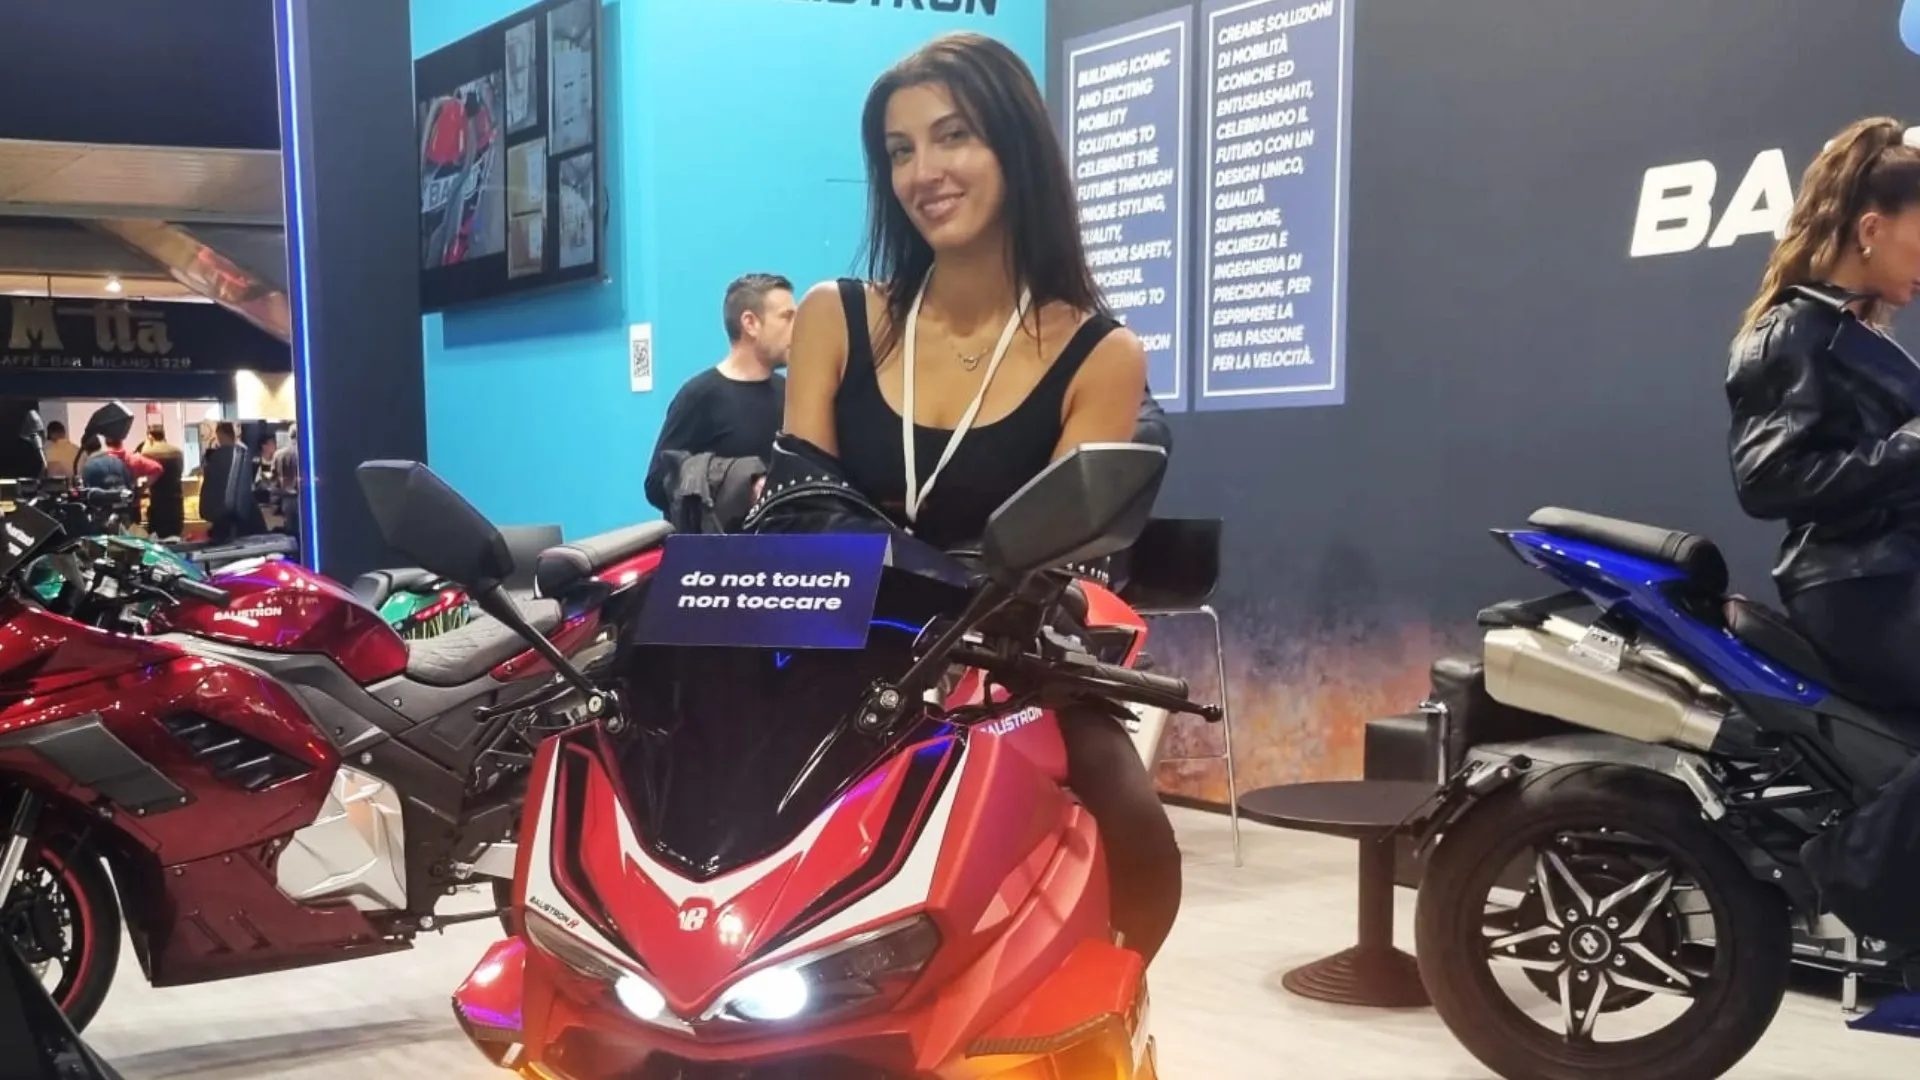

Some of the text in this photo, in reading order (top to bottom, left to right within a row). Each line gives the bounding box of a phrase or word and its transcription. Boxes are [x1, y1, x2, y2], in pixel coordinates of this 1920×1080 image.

[1218, 0, 1333, 45] CREARE SOLUZIONI
[1217, 33, 1288, 69] DI MOBILITÀ
[1078, 48, 1171, 88] BUILDING ICONIC
[1217, 60, 1295, 93] ICONICHE ED
[1077, 77, 1154, 111] AND EXCITING
[1077, 106, 1128, 134] MOBILITY
[1216, 105, 1310, 140] CELEBRANDO IL
[1076, 124, 1155, 157] SOLUTIONS TO
[1215, 128, 1314, 164] FUTURO CON UN
[1077, 146, 1159, 178] CELEBRATE THE
[1215, 155, 1304, 188] DESIGN UNICO,
[1077, 168, 1174, 202] FUTURE THROUGH
[1215, 183, 1265, 210] QUALITÀ
[1117, 194, 1166, 219] STYLING,
[1214, 208, 1282, 234] SUPERIORE,
[1129, 240, 1172, 261] SAFETY,
[1214, 230, 1289, 257] SICUREZZA E
[1213, 253, 1303, 280] INGEGNERIA DI
[1148, 286, 1165, 305] TO
[1213, 275, 1311, 304] PRECISIONE, PER
[1213, 301, 1294, 326] ESPRIMERE LA
[1213, 324, 1305, 349] VERA PASSIONE
[1212, 344, 1315, 371] PER LA VELOCITÀ.
[681, 571, 851, 588] do not touch
[678, 594, 842, 610] non toccare
